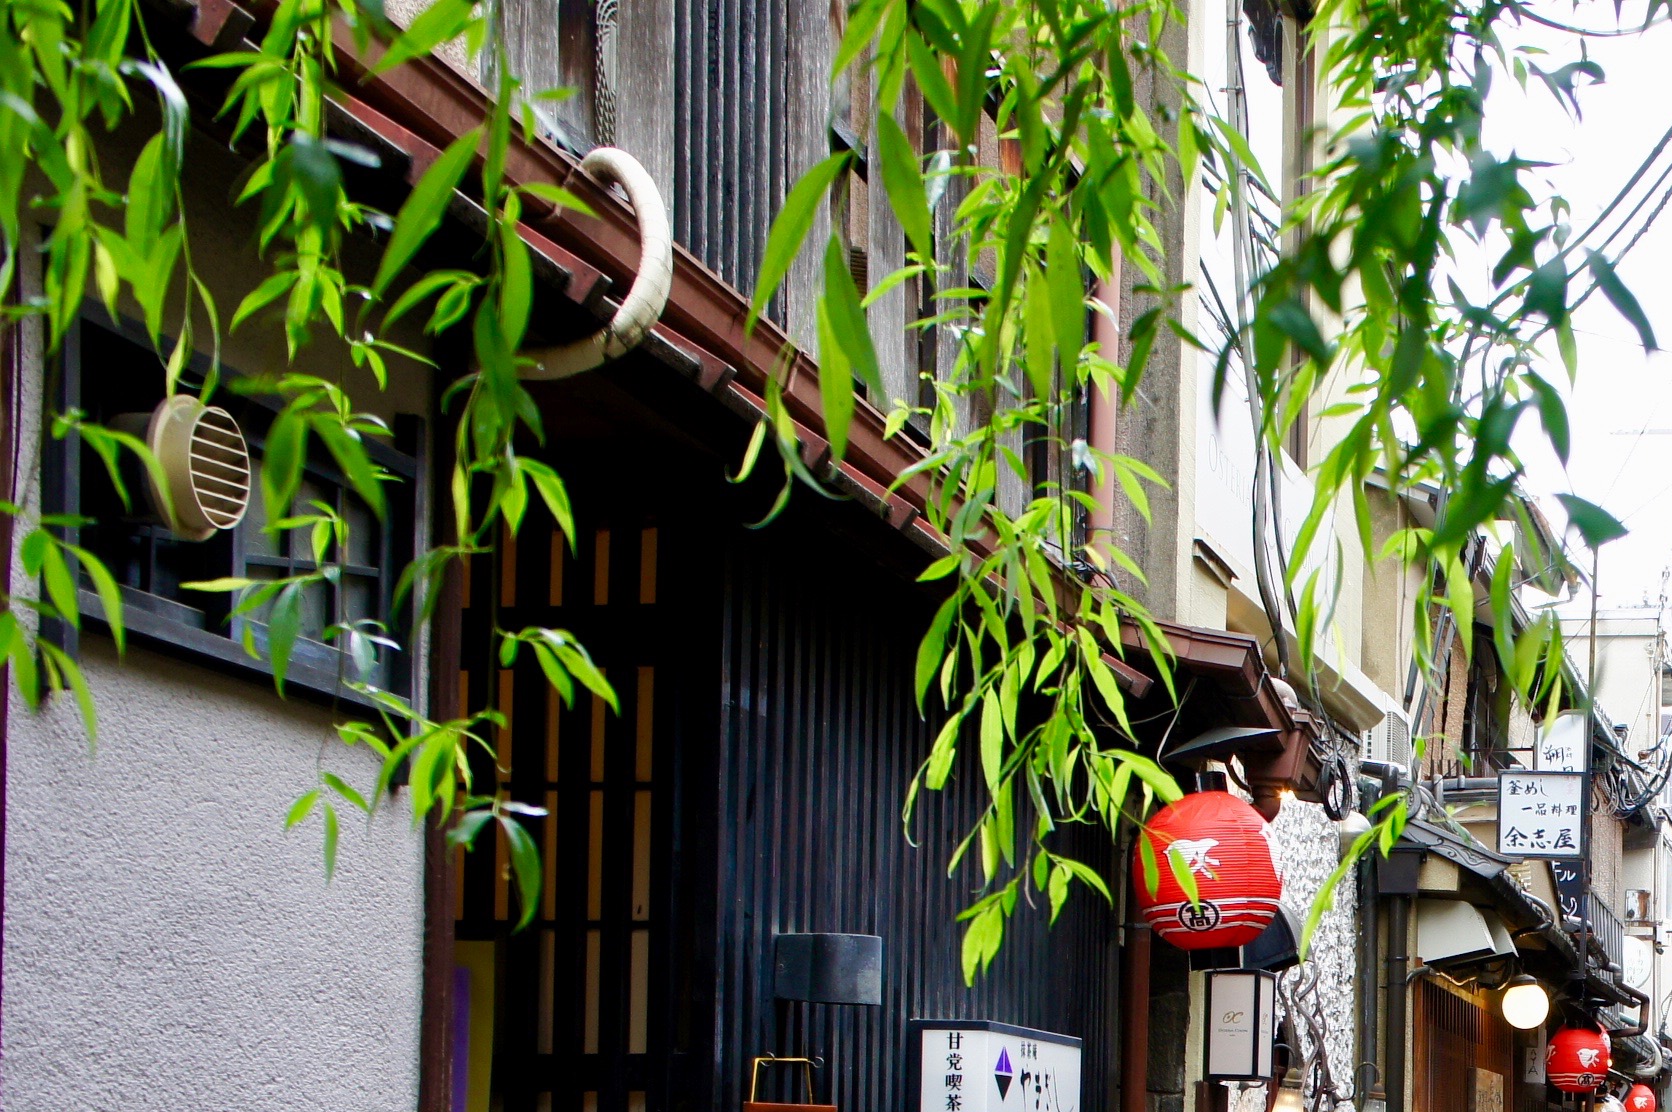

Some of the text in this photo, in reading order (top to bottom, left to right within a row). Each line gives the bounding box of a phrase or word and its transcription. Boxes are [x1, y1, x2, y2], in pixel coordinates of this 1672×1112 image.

[1507, 778, 1549, 797] 釜めし
[1521, 803, 1578, 817] 一品料理
[1504, 826, 1577, 850] 余志屋
[945, 1032, 964, 1112] 甘党喫茶
